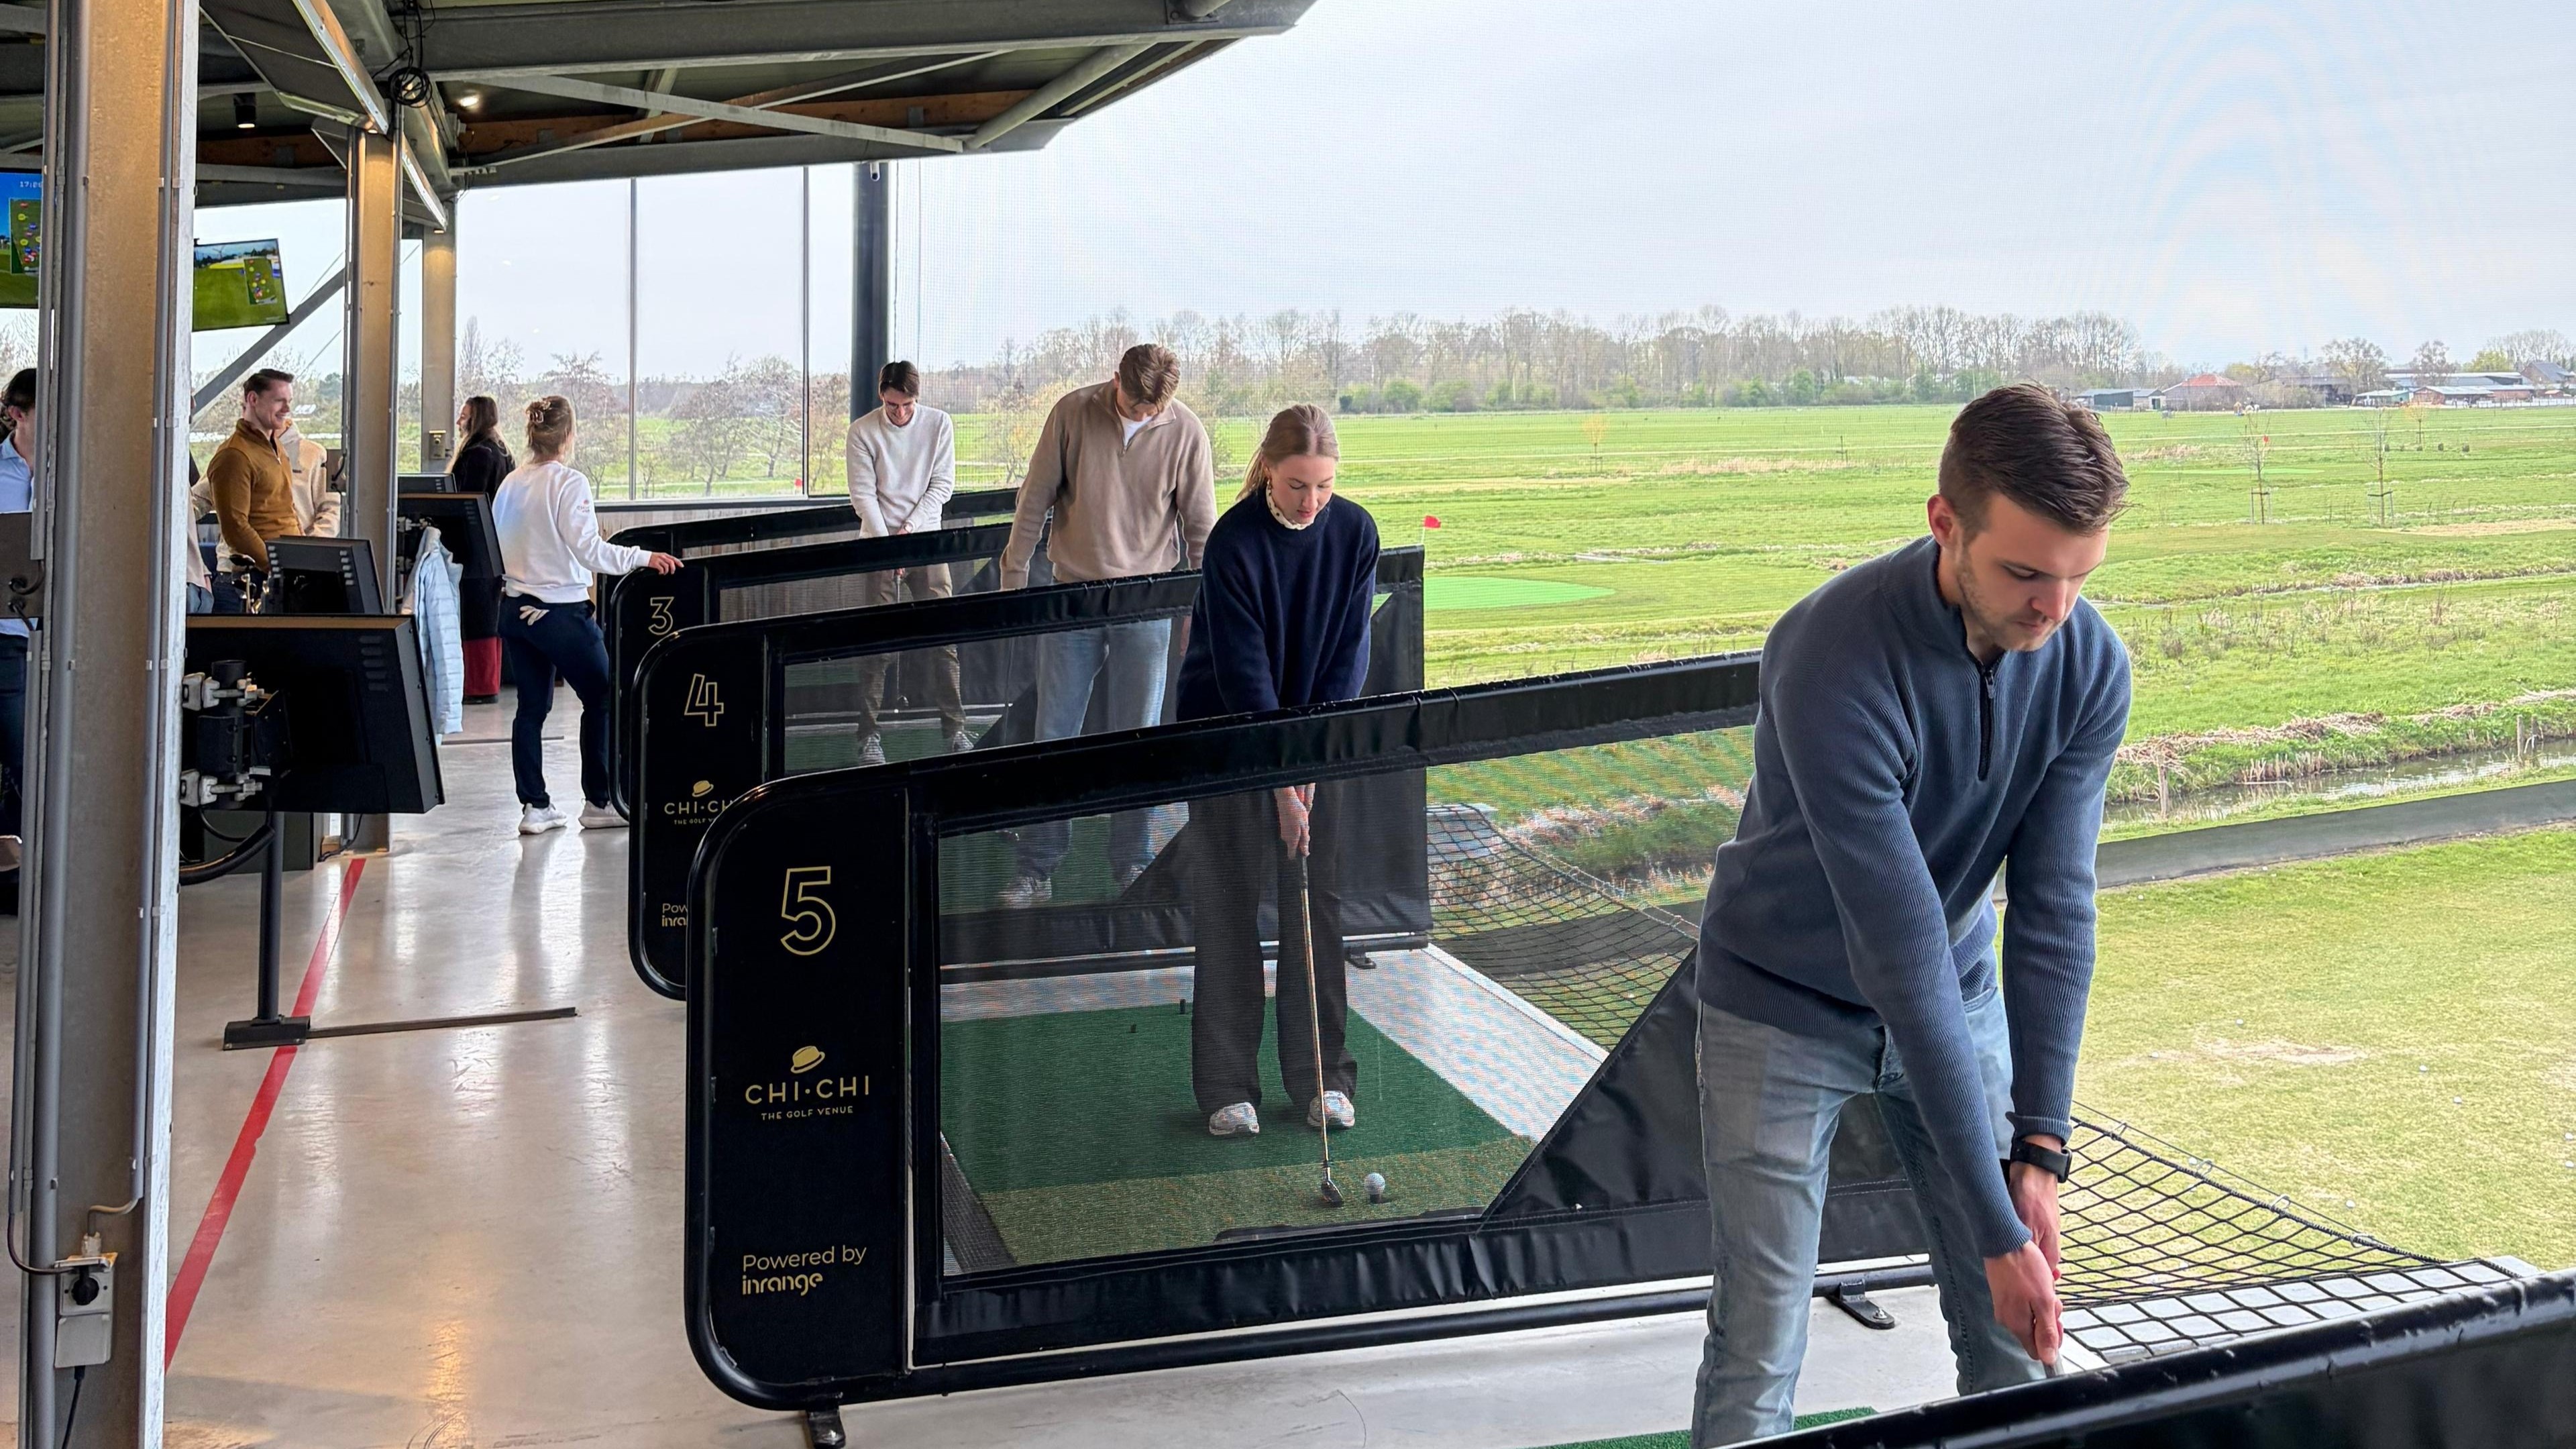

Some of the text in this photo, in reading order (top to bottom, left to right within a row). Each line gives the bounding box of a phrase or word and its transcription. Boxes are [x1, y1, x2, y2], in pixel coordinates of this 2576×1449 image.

[648, 596, 675, 635] 3
[684, 673, 724, 727] 4
[780, 865, 836, 956] 5
[761, 1106, 853, 1121] THE GOLF VENUE
[743, 1244, 867, 1272] Powered by
[742, 1273, 823, 1296] inrange
